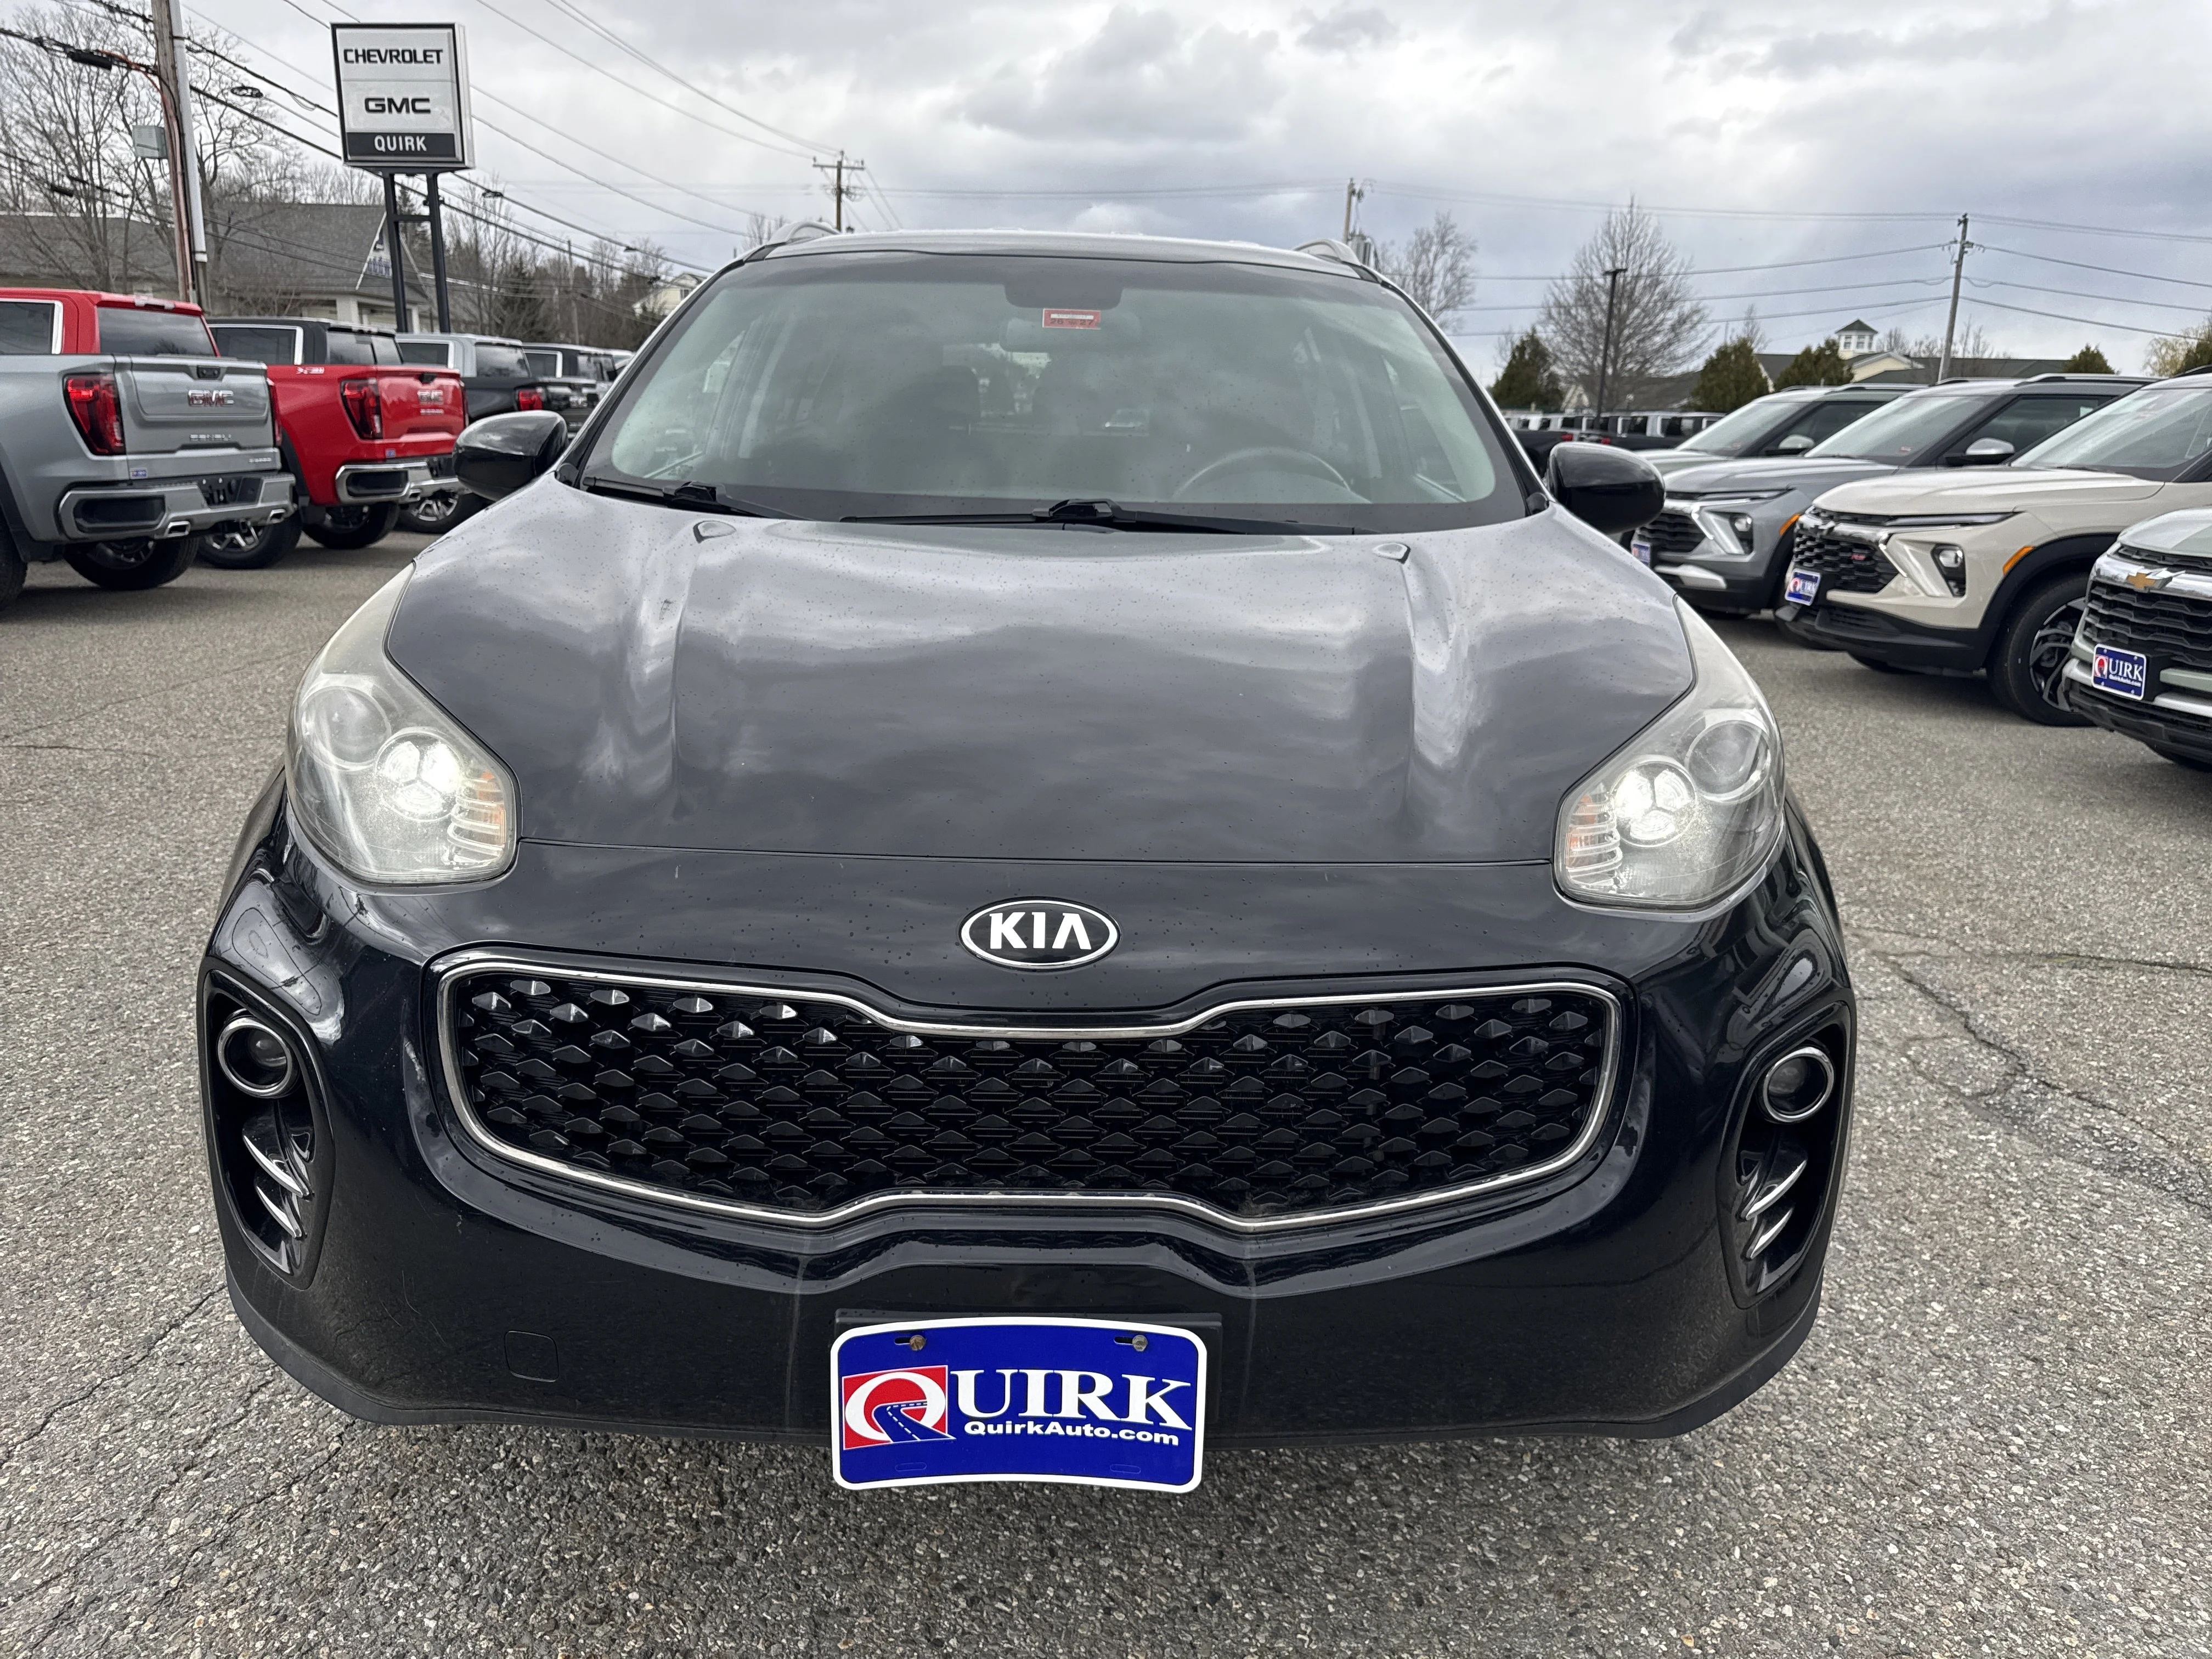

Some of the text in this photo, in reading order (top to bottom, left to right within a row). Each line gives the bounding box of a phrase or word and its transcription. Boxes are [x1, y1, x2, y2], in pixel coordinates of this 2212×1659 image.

[343, 48, 443, 65] CHEVROLET
[364, 98, 431, 114] GMC
[374, 135, 427, 152] QUIRK
[188, 390, 235, 407] GMC
[2095, 656, 2143, 682] QUIRK
[989, 911, 1092, 950] KIA
[844, 1368, 1192, 1444] QUIRK
[964, 1421, 1179, 1447] QuirkAuto.com
